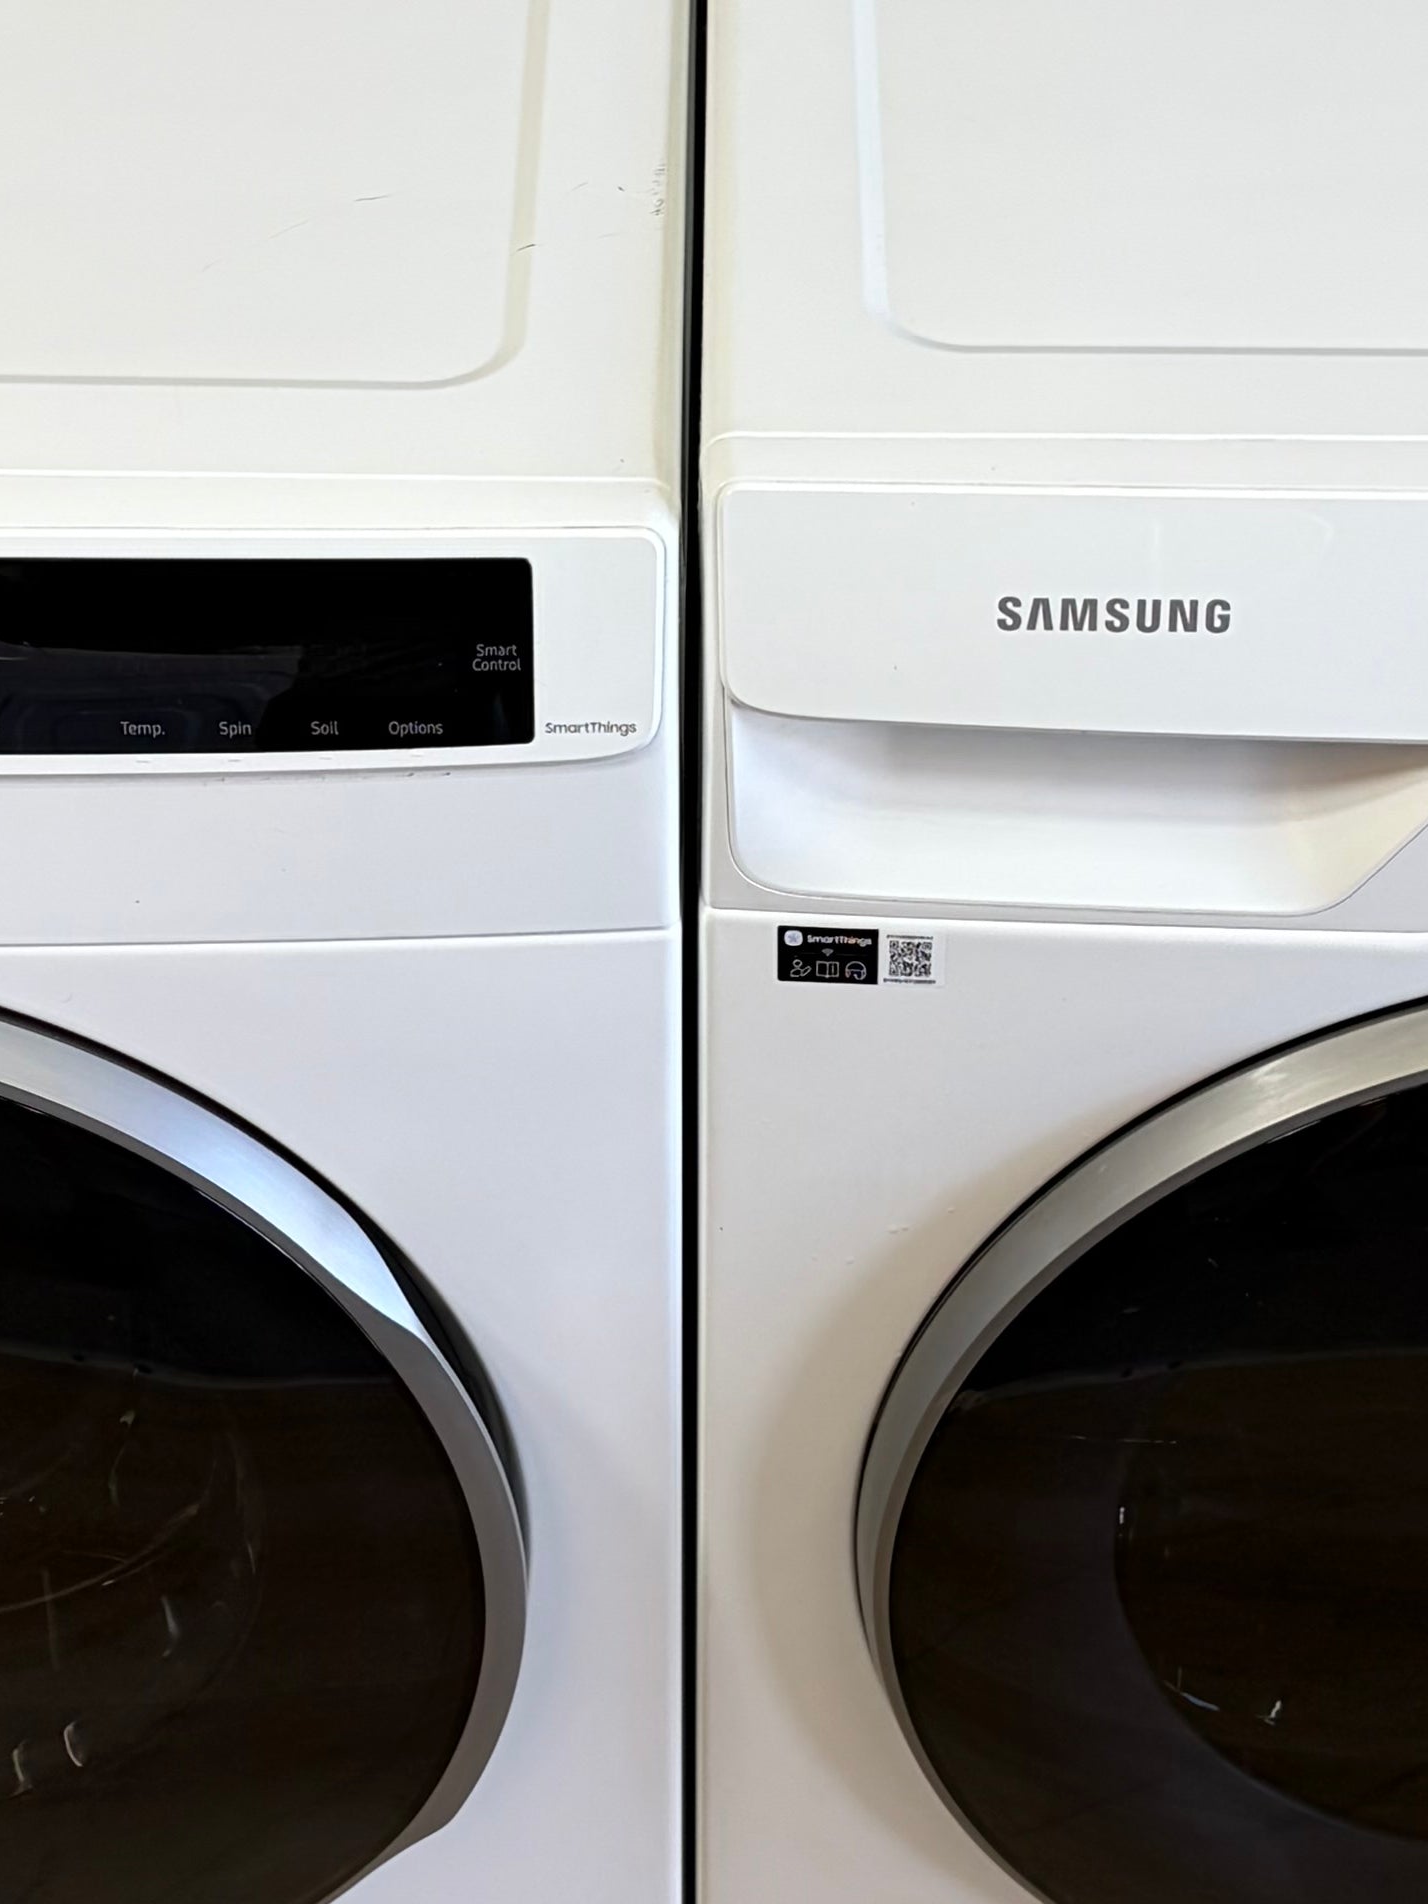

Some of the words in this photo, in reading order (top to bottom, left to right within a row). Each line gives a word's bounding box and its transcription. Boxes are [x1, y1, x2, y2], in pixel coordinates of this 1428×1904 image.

[996, 596, 1232, 634] SAMSUNG
[476, 643, 518, 657] Smart
[472, 657, 522, 672] Control
[120, 721, 166, 738] Temp.
[218, 721, 252, 738] Spin
[310, 721, 339, 736] Soil
[388, 721, 444, 737] Options
[544, 721, 638, 736] SmartThings
[807, 934, 873, 947] SmartThings
